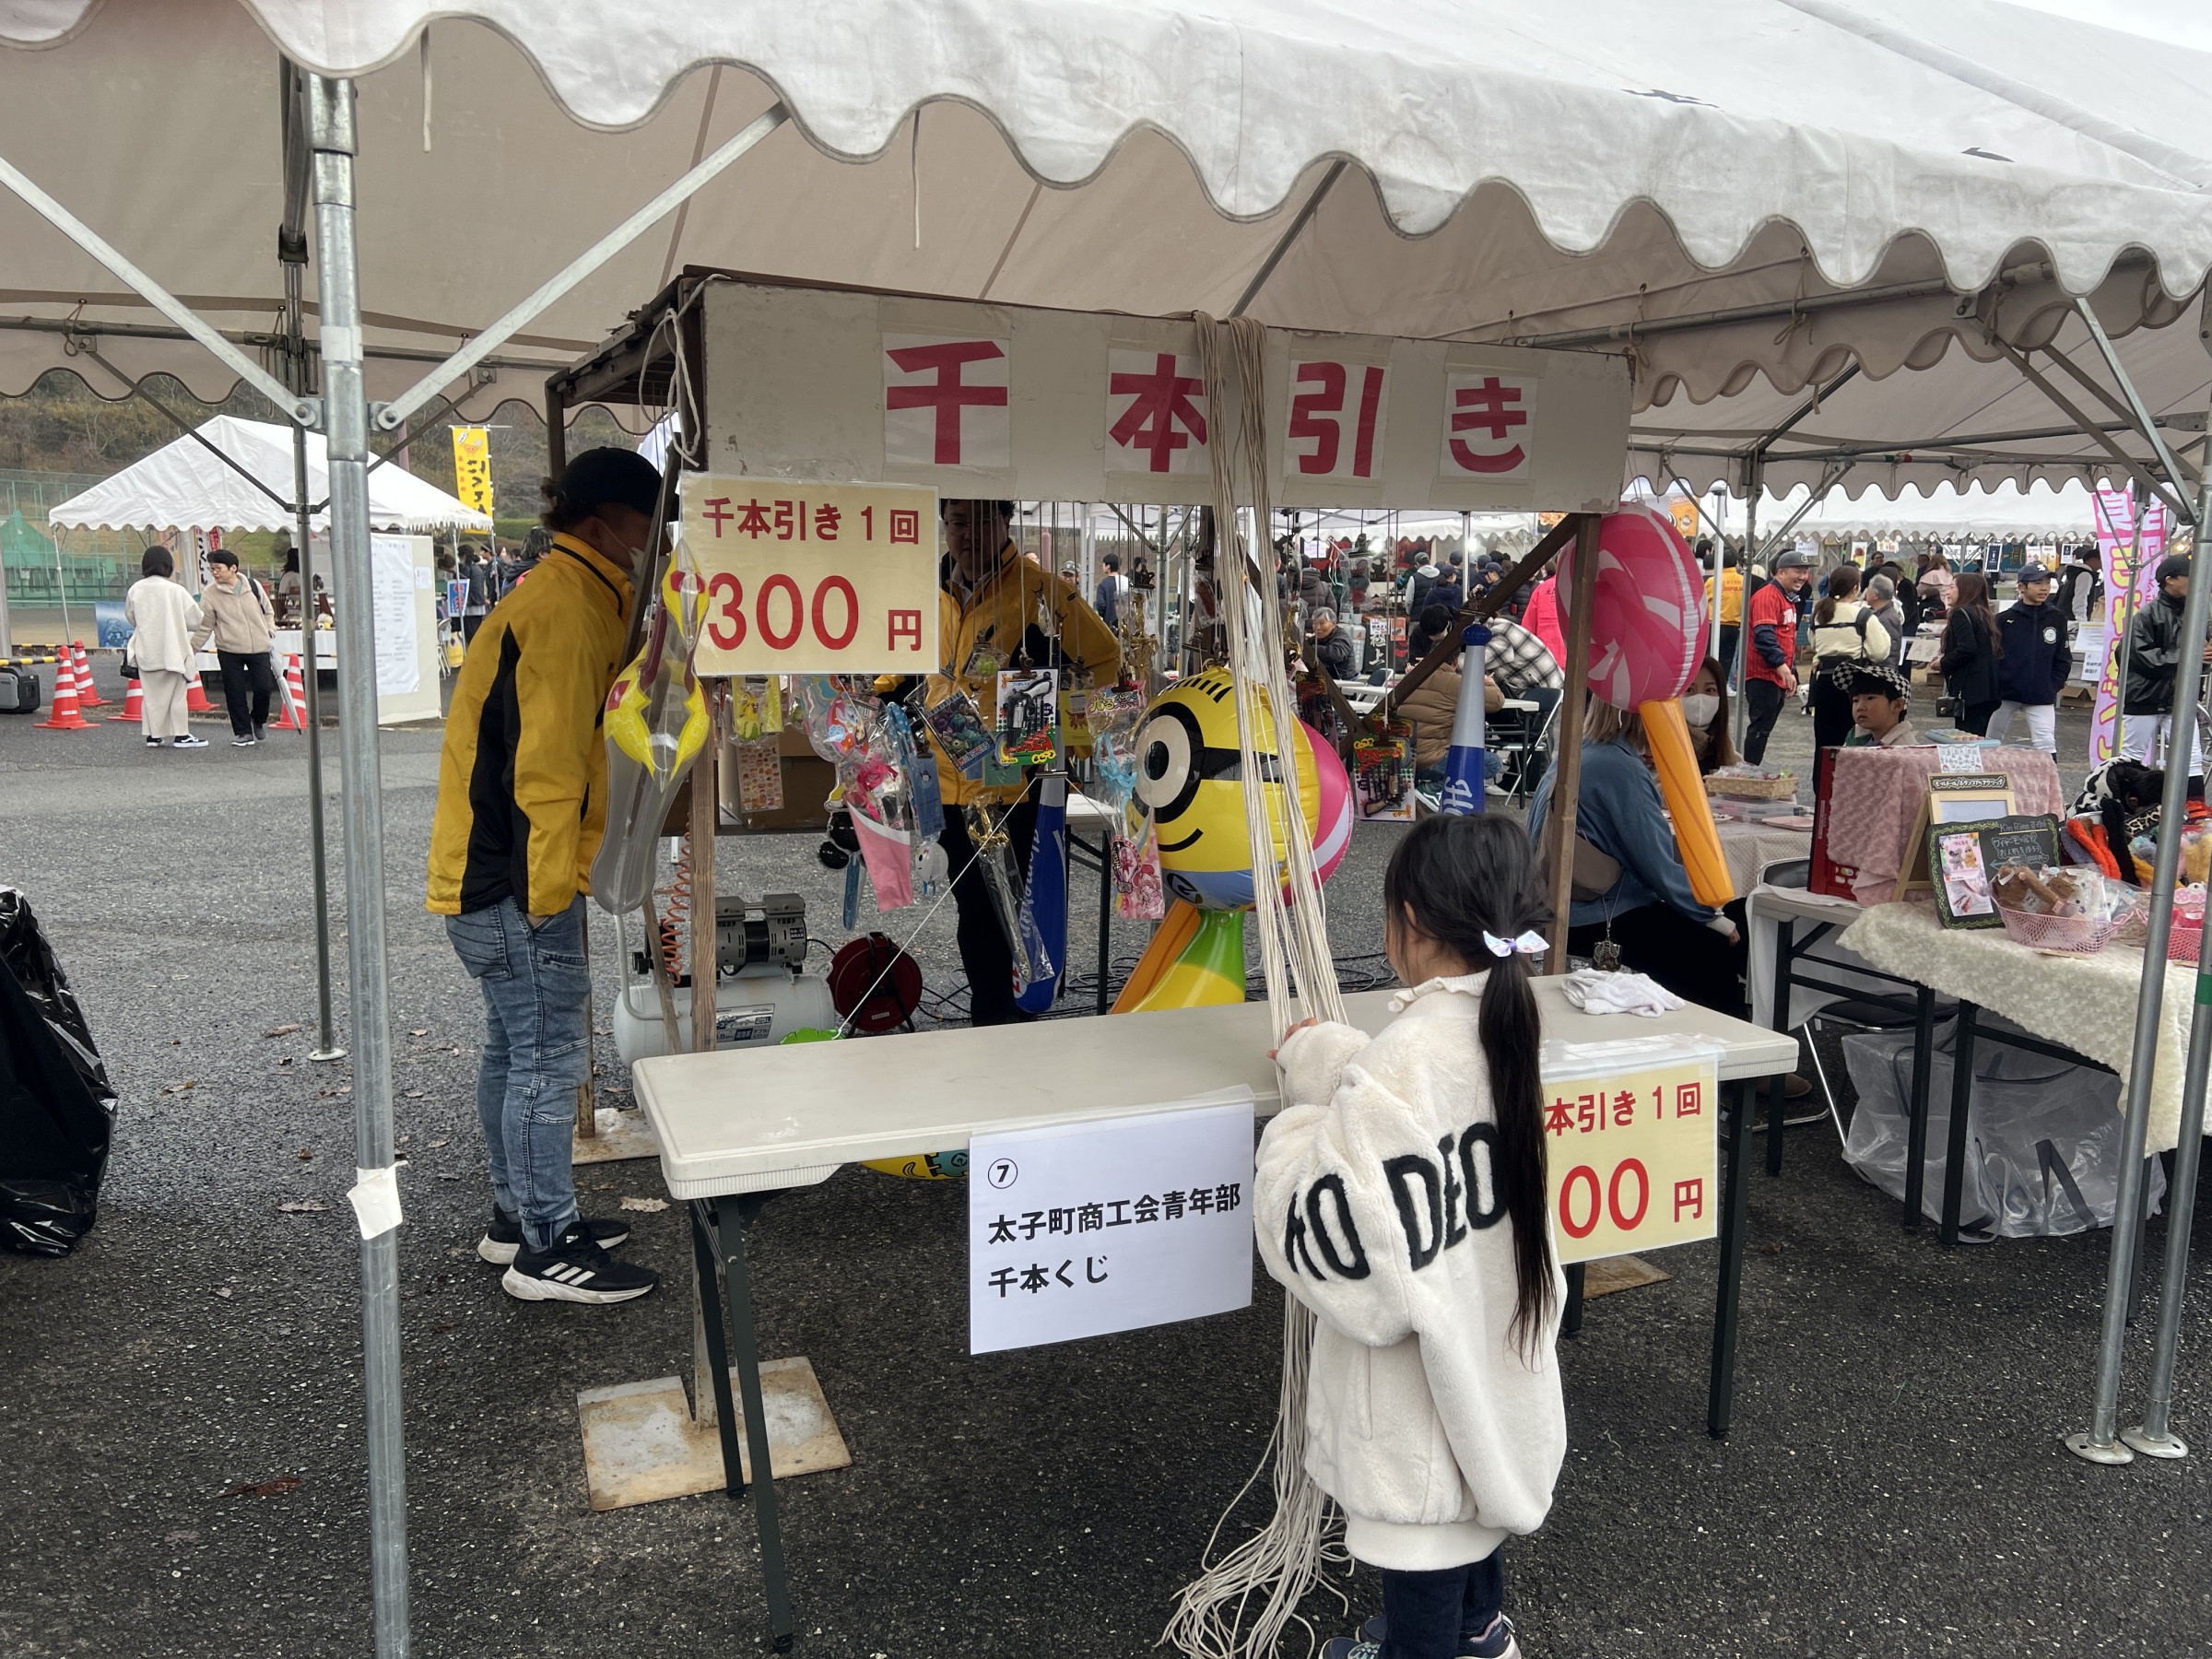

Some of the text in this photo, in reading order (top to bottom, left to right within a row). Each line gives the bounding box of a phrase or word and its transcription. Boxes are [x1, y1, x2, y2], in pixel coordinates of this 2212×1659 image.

[886, 340, 1527, 477] 千本引き
[708, 572, 921, 651] 300 円
[988, 1182, 1241, 1245] 太子町商工会青年部
[1674, 1178, 1702, 1223] 円
[988, 1255, 1109, 1298] 千本くじ
